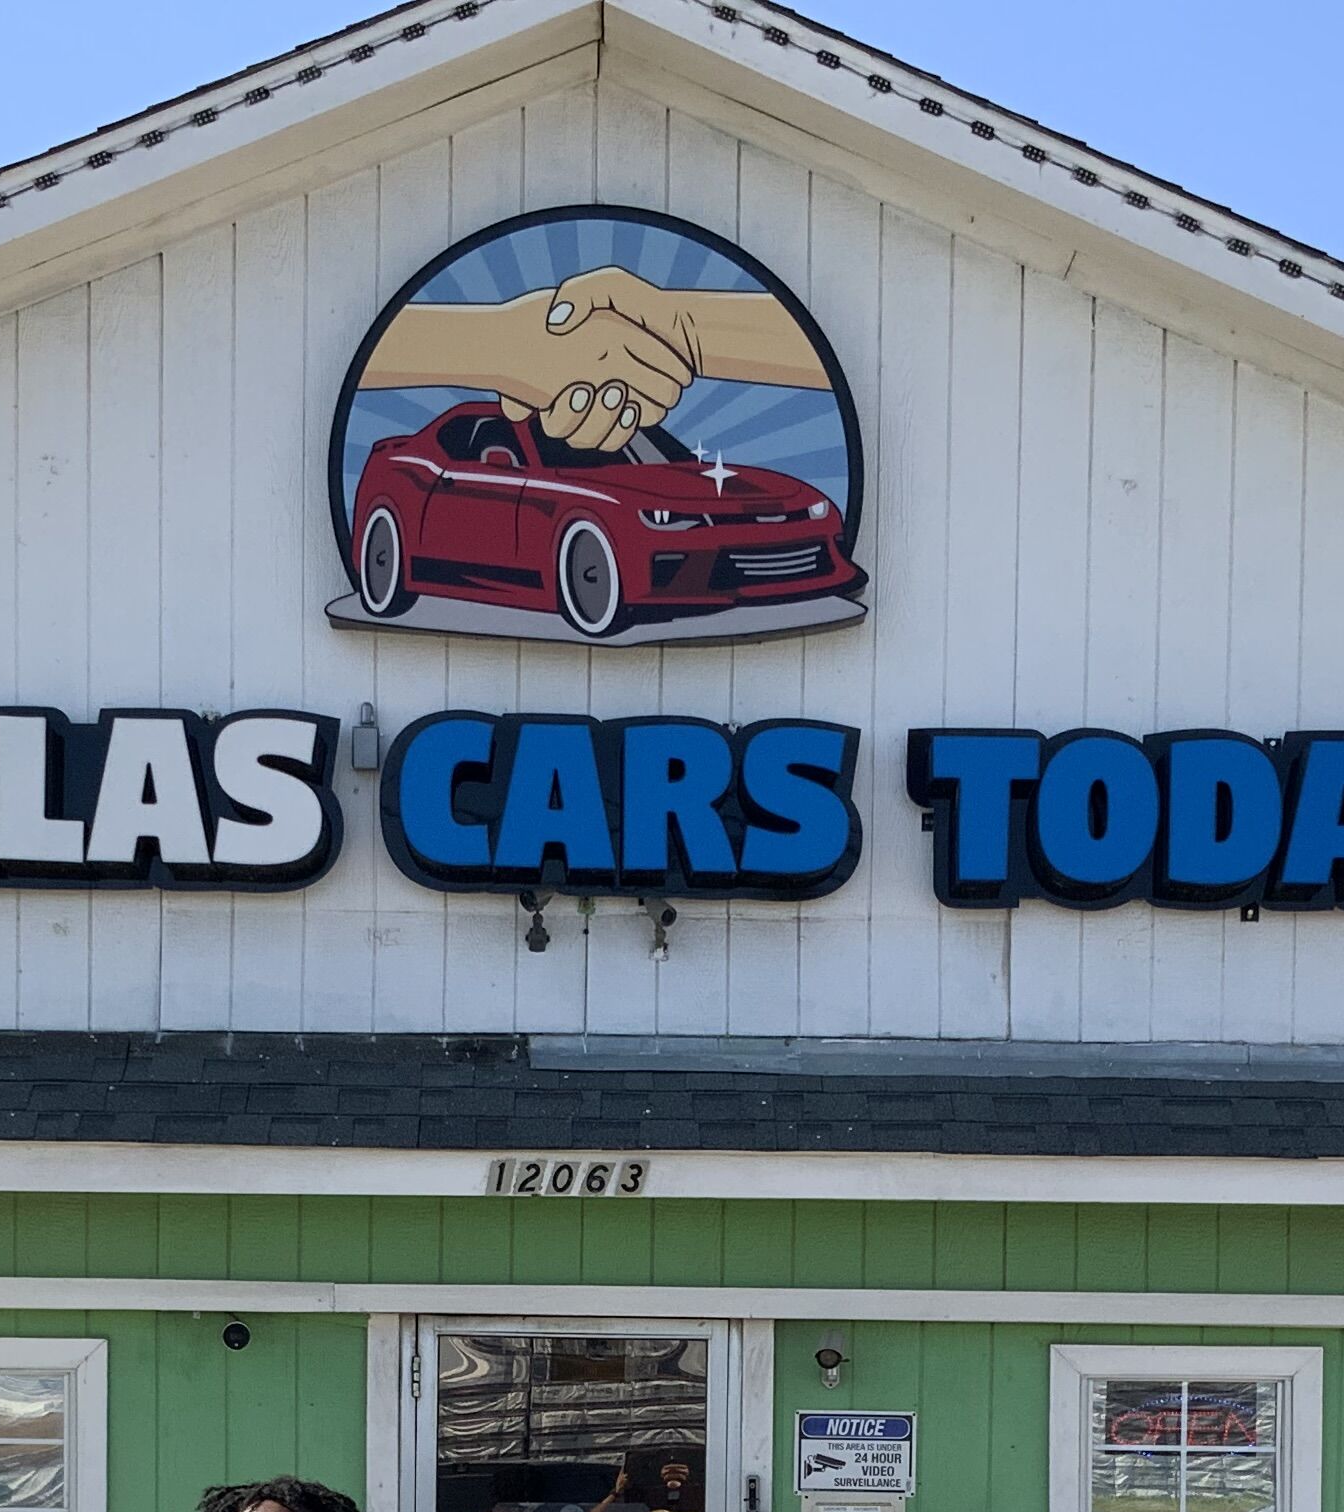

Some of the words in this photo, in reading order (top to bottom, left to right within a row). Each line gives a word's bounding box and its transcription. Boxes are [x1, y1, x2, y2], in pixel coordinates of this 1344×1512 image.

[397, 717, 853, 879] CARS
[495, 1161, 644, 1194] 12063
[825, 1418, 887, 1437] NOTICE
[827, 1442, 845, 1451] THIS
[845, 1442, 866, 1451] AREA
[867, 1442, 875, 1451] IS
[876, 1443, 902, 1452] UNDER
[854, 1452, 868, 1464] 24
[871, 1452, 902, 1464] HOUR
[861, 1465, 895, 1477] VIDEO
[834, 1477, 902, 1488] SURVEILLANCE
